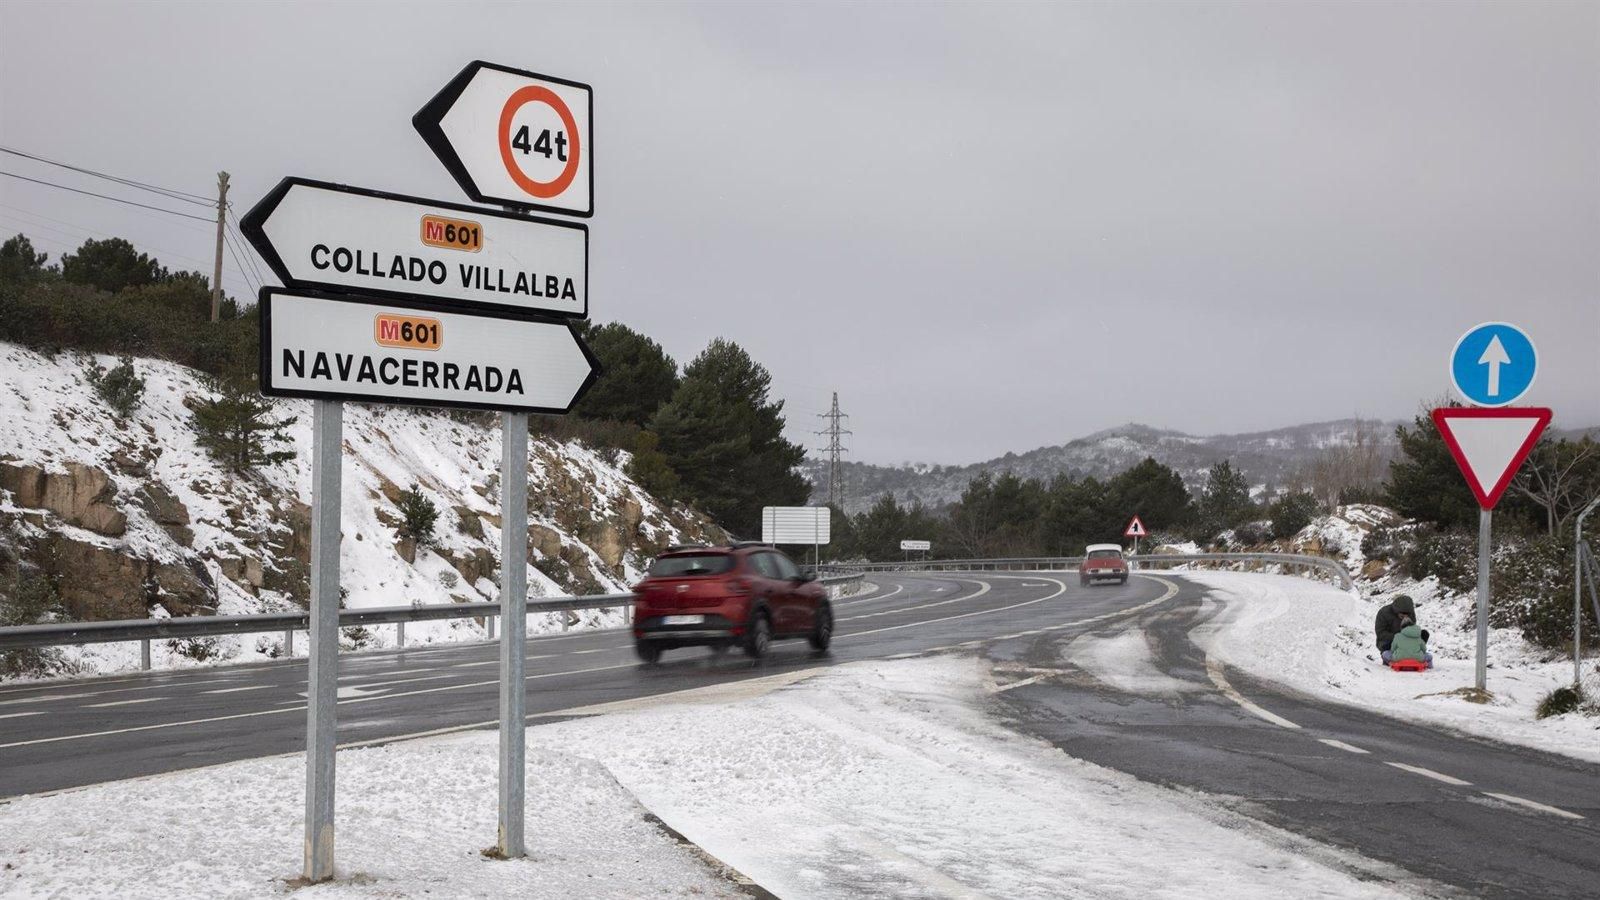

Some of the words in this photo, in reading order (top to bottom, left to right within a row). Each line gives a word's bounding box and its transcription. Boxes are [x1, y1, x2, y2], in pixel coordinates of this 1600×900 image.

[512, 125, 567, 162] 44t
[425, 220, 480, 248] M601
[310, 244, 447, 285] COLLADO
[459, 263, 577, 301] VILLALBA
[379, 318, 438, 345] M601
[282, 348, 525, 395] NAVACERRADA
